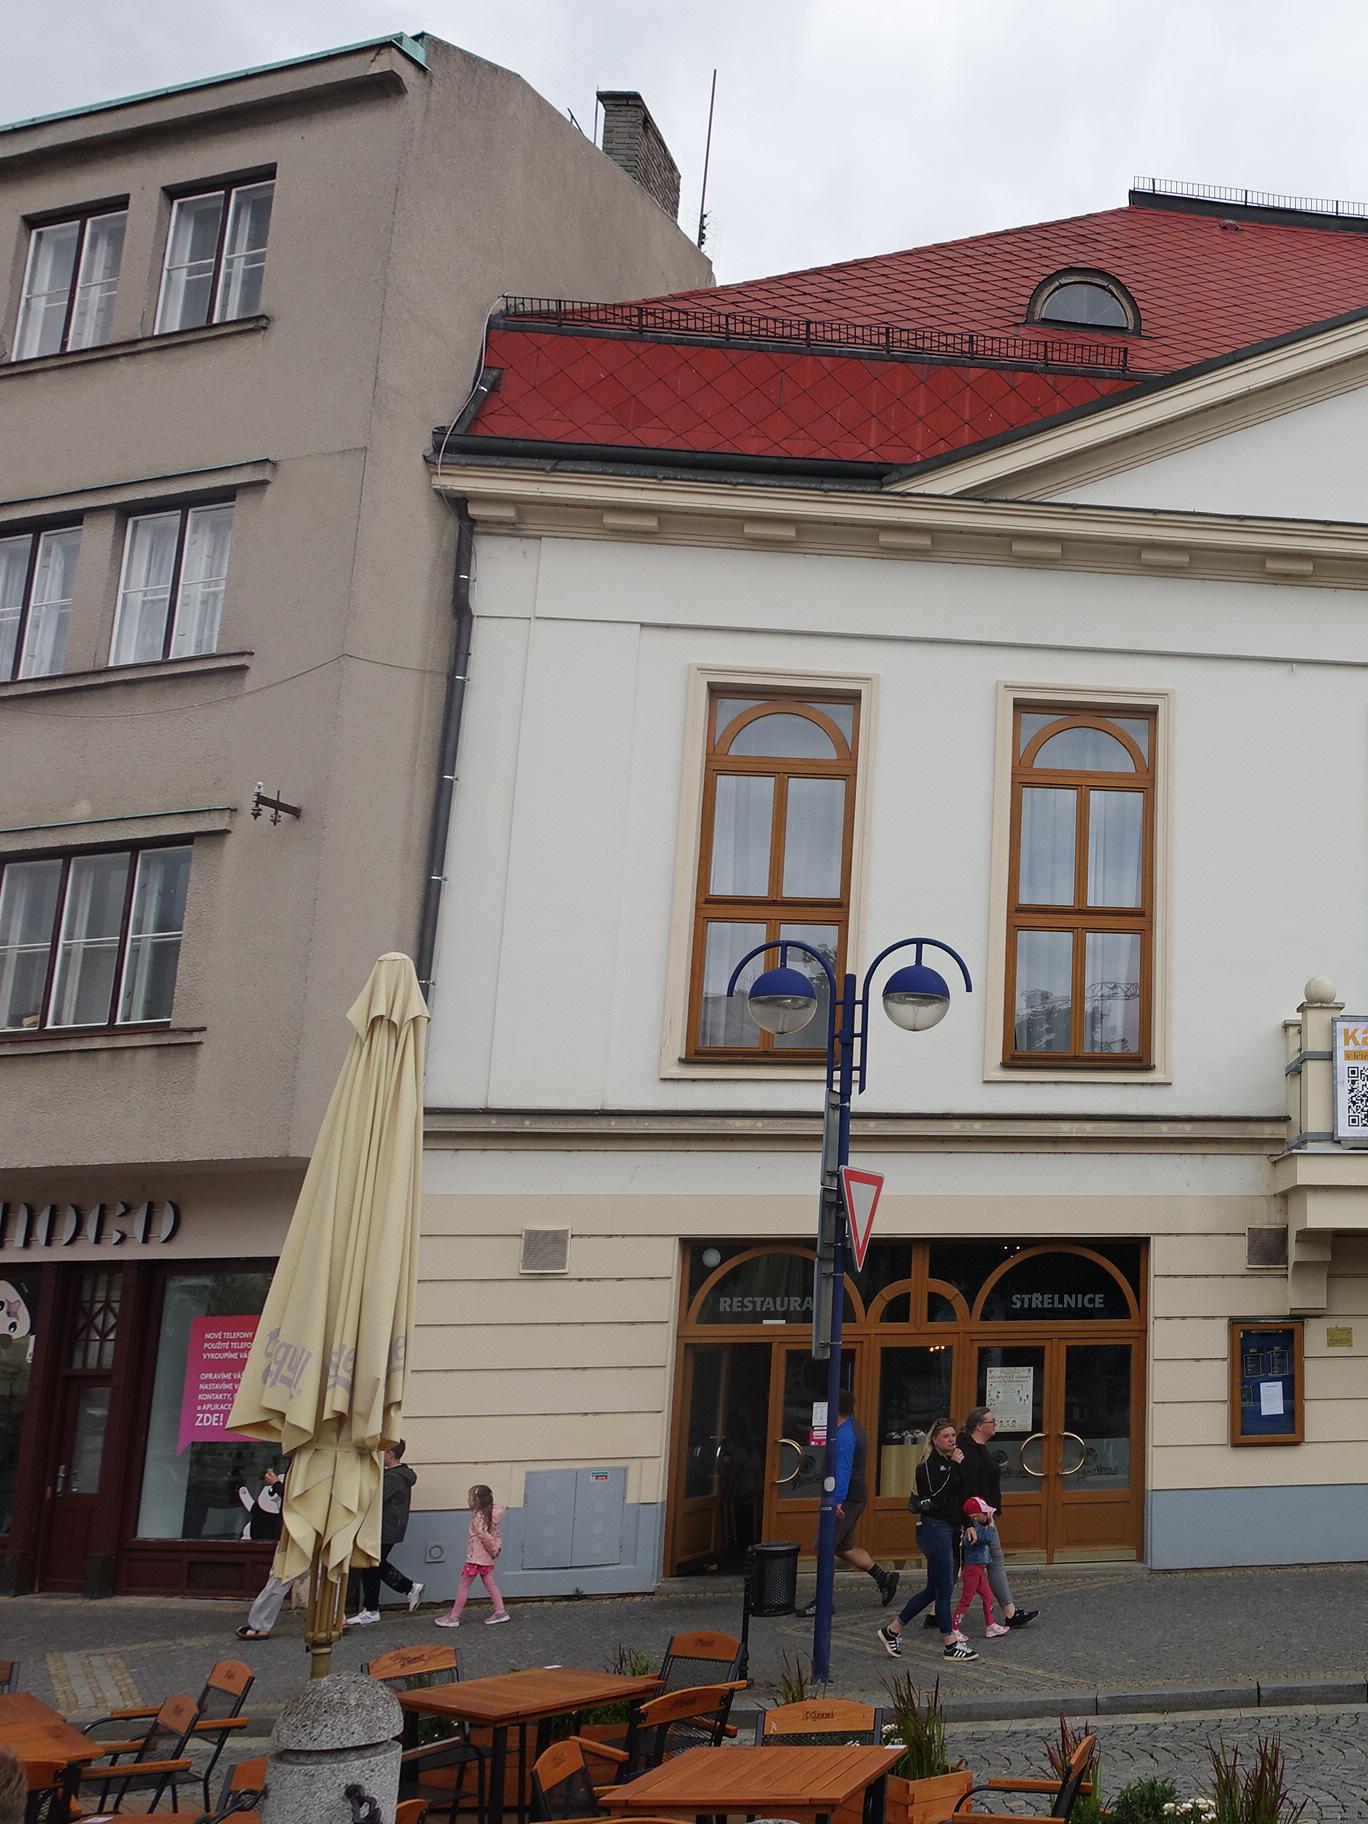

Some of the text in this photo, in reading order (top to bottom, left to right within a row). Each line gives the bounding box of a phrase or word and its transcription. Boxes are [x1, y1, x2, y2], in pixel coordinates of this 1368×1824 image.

[1011, 1292, 1104, 1308] STŘELNICE
[204, 1342, 229, 1350] POUŽITÉ
[200, 1372, 232, 1380] OPRAVÍME
[199, 1382, 233, 1390] NASTAVÍME
[198, 1393, 232, 1401] KONTAKTY,
[195, 1414, 224, 1426] ZDE!
